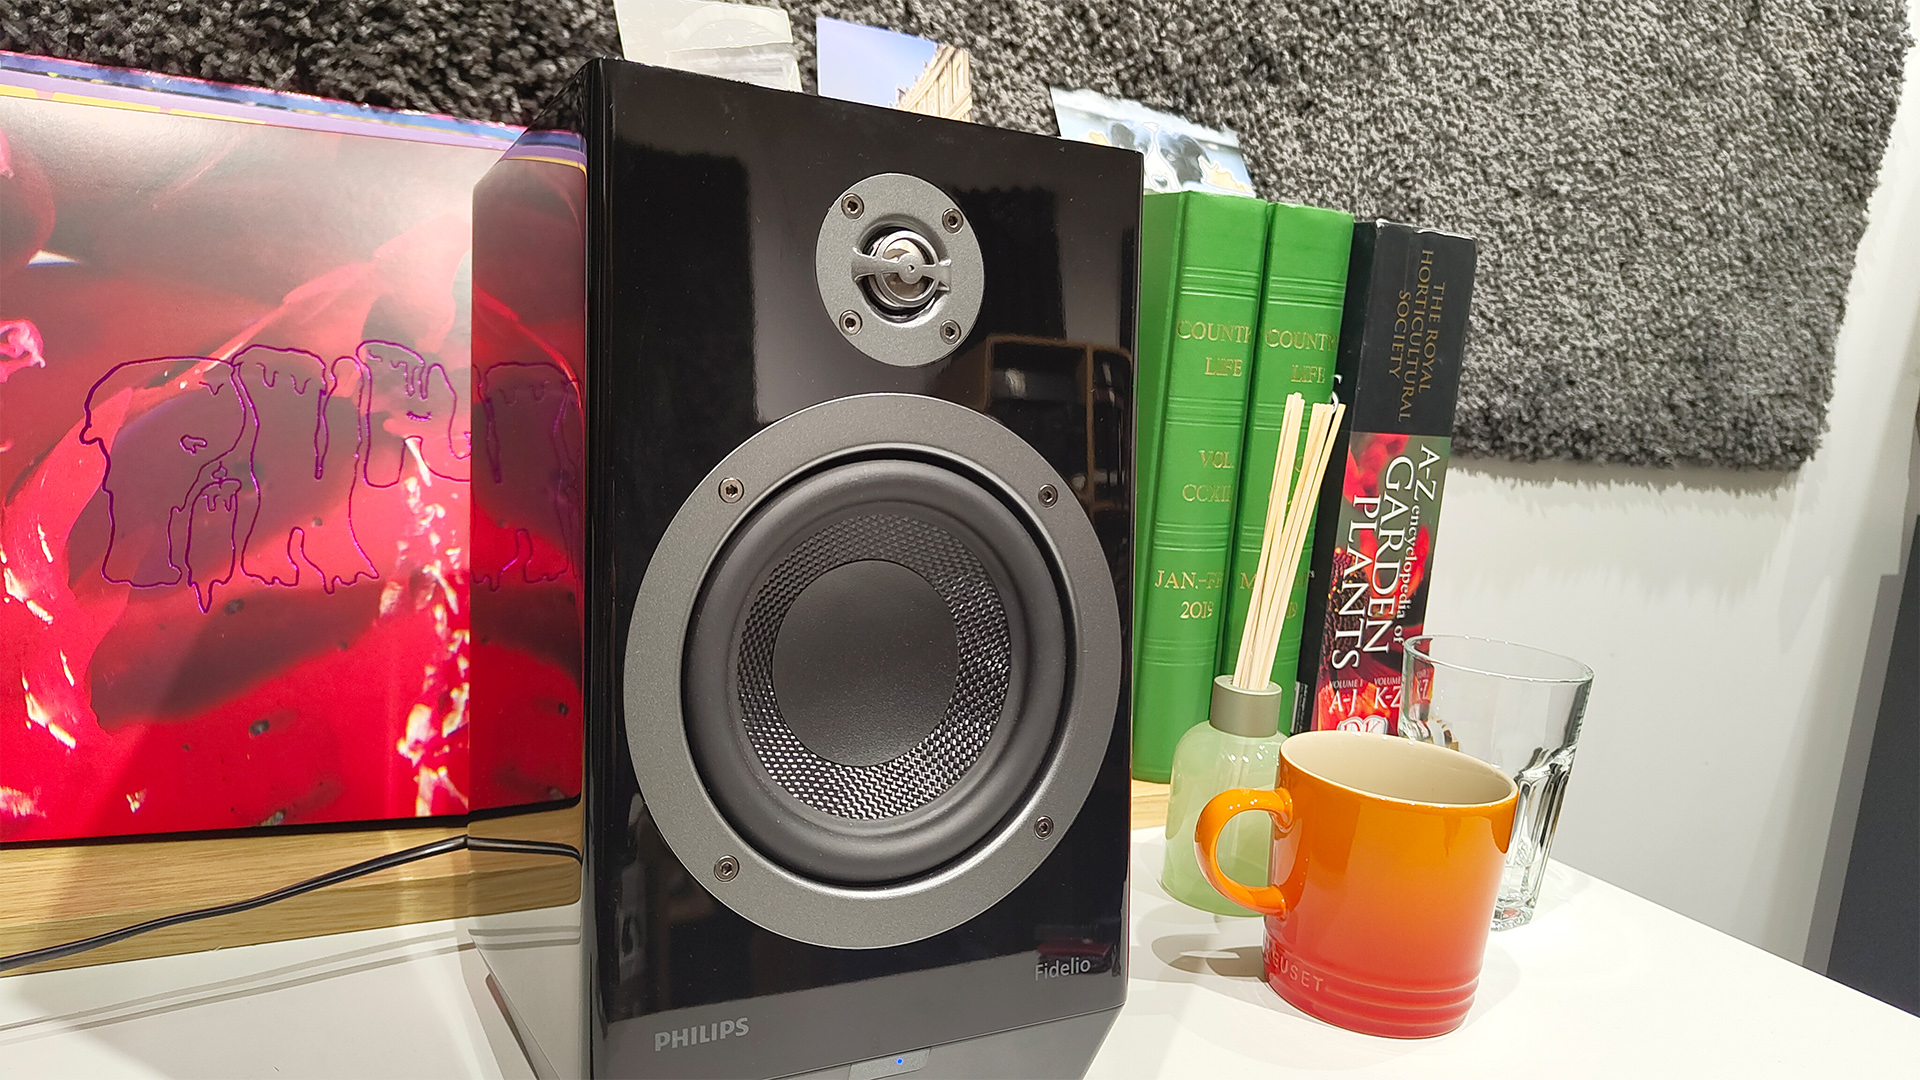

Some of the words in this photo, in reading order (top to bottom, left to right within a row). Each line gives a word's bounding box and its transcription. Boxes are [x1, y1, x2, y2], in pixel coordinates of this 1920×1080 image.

[1428, 282, 1446, 324] THE
[1388, 290, 1411, 379] SOCIETY
[1398, 249, 1434, 422] HORTICULTURAL
[1204, 356, 1243, 377] LIFE
[1290, 364, 1326, 384] LIFE
[1418, 329, 1439, 393] ROYAL
[1413, 443, 1441, 501] A-Z
[1362, 456, 1415, 654] GARDEN
[1396, 504, 1422, 620] encyclopedia
[1331, 494, 1382, 669] PLANTS
[1180, 601, 1214, 619] 2019
[1328, 688, 1358, 717] A-J
[1329, 680, 1359, 690] VOLUME
[1034, 956, 1092, 982] Fidelio
[654, 1017, 750, 1052] PHILIPS
